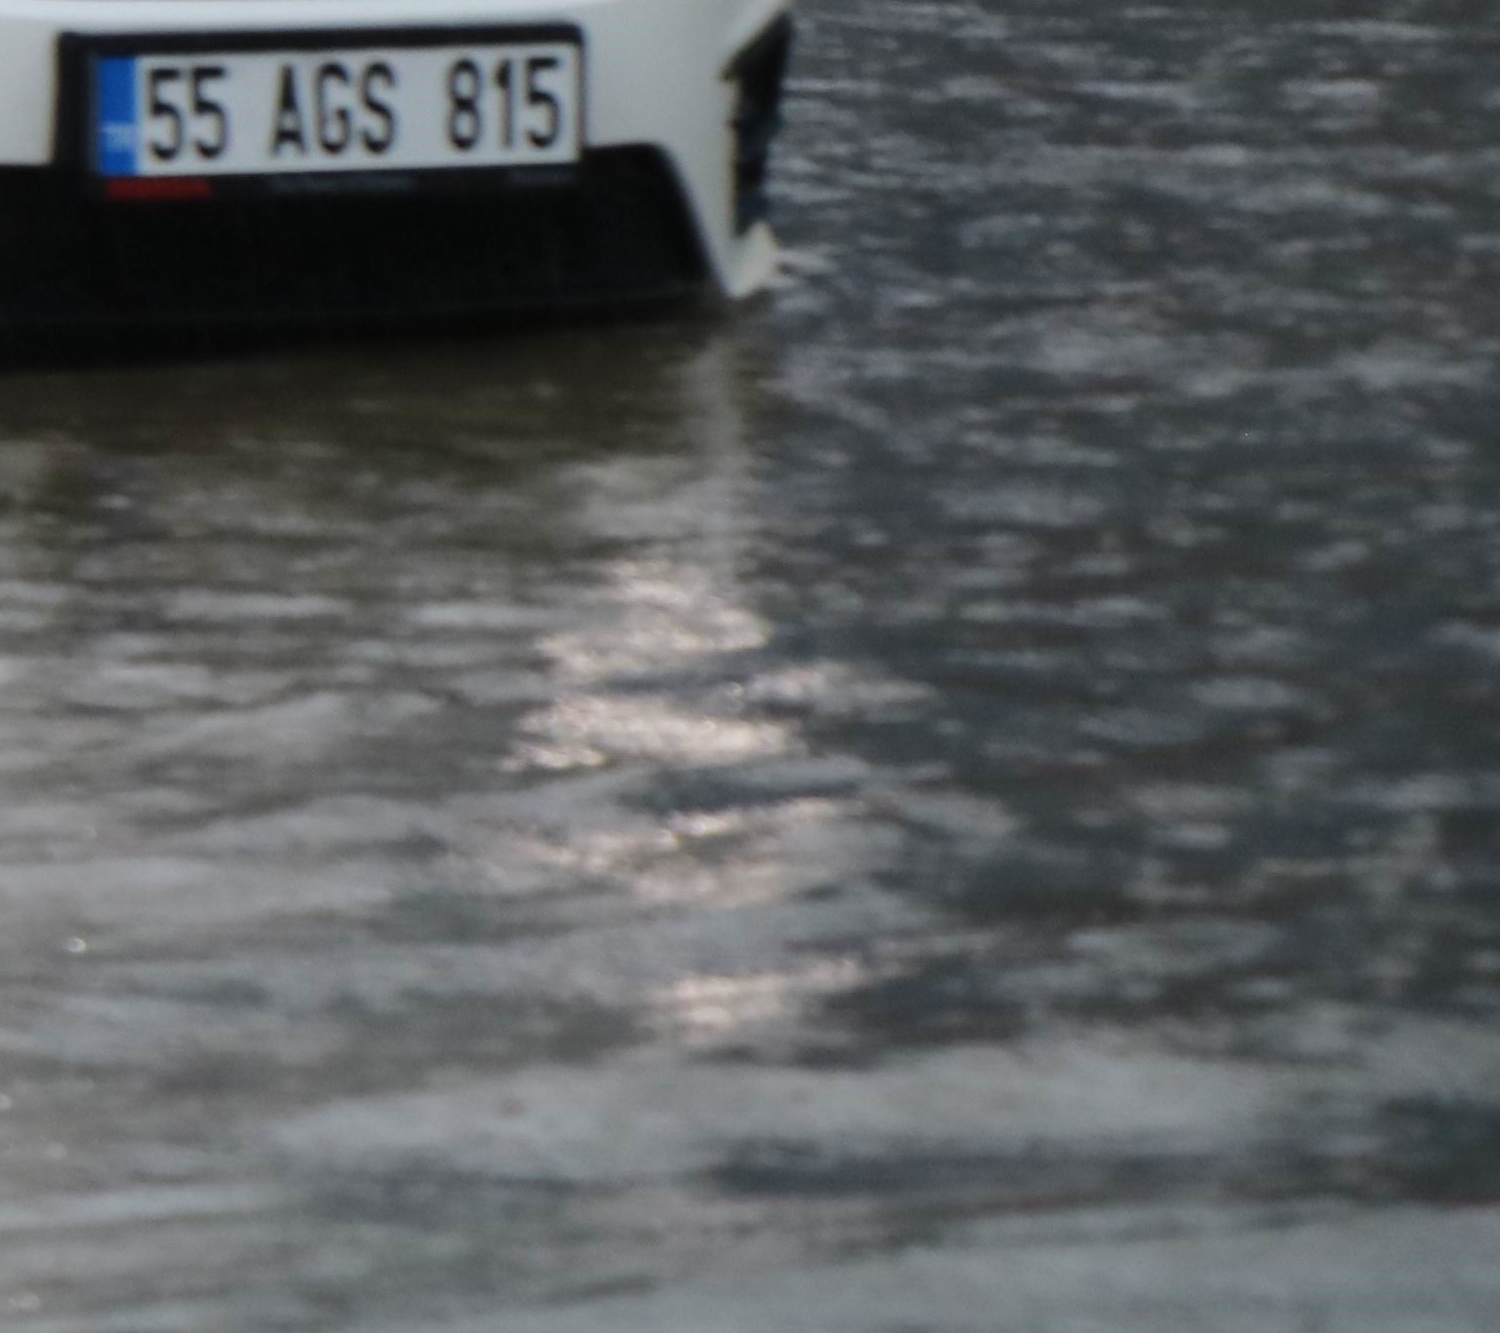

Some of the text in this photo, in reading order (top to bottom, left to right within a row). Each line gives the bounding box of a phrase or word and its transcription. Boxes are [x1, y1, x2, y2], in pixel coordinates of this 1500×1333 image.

[146, 57, 563, 159] 55 AGS 815
